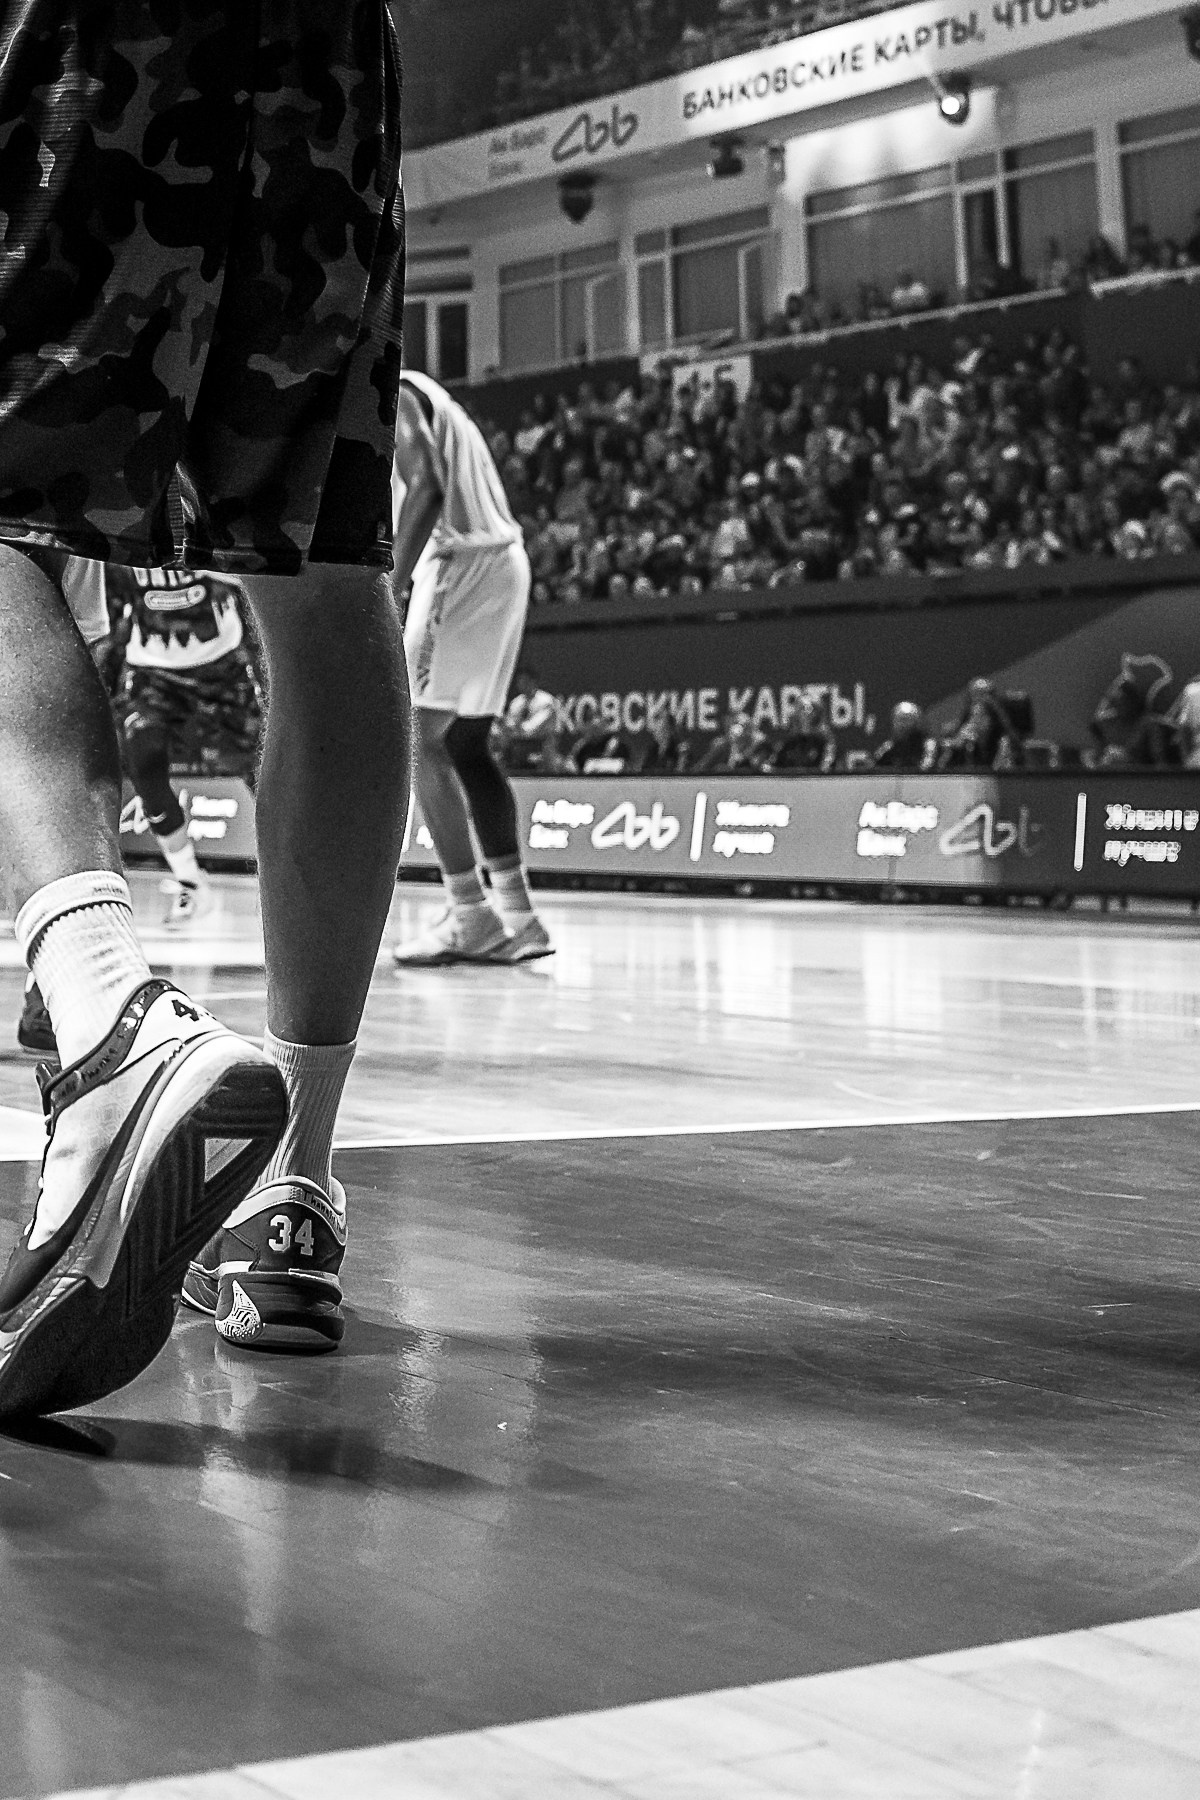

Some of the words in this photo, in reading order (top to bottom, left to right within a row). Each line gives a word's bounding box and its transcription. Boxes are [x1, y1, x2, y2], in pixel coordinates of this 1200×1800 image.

[681, 43, 865, 120] БАНКОВСКИЕ
[873, 9, 986, 67] КАРТЫ,
[553, 688, 718, 732] КОВСКИЕ
[268, 1214, 315, 1256] 34
